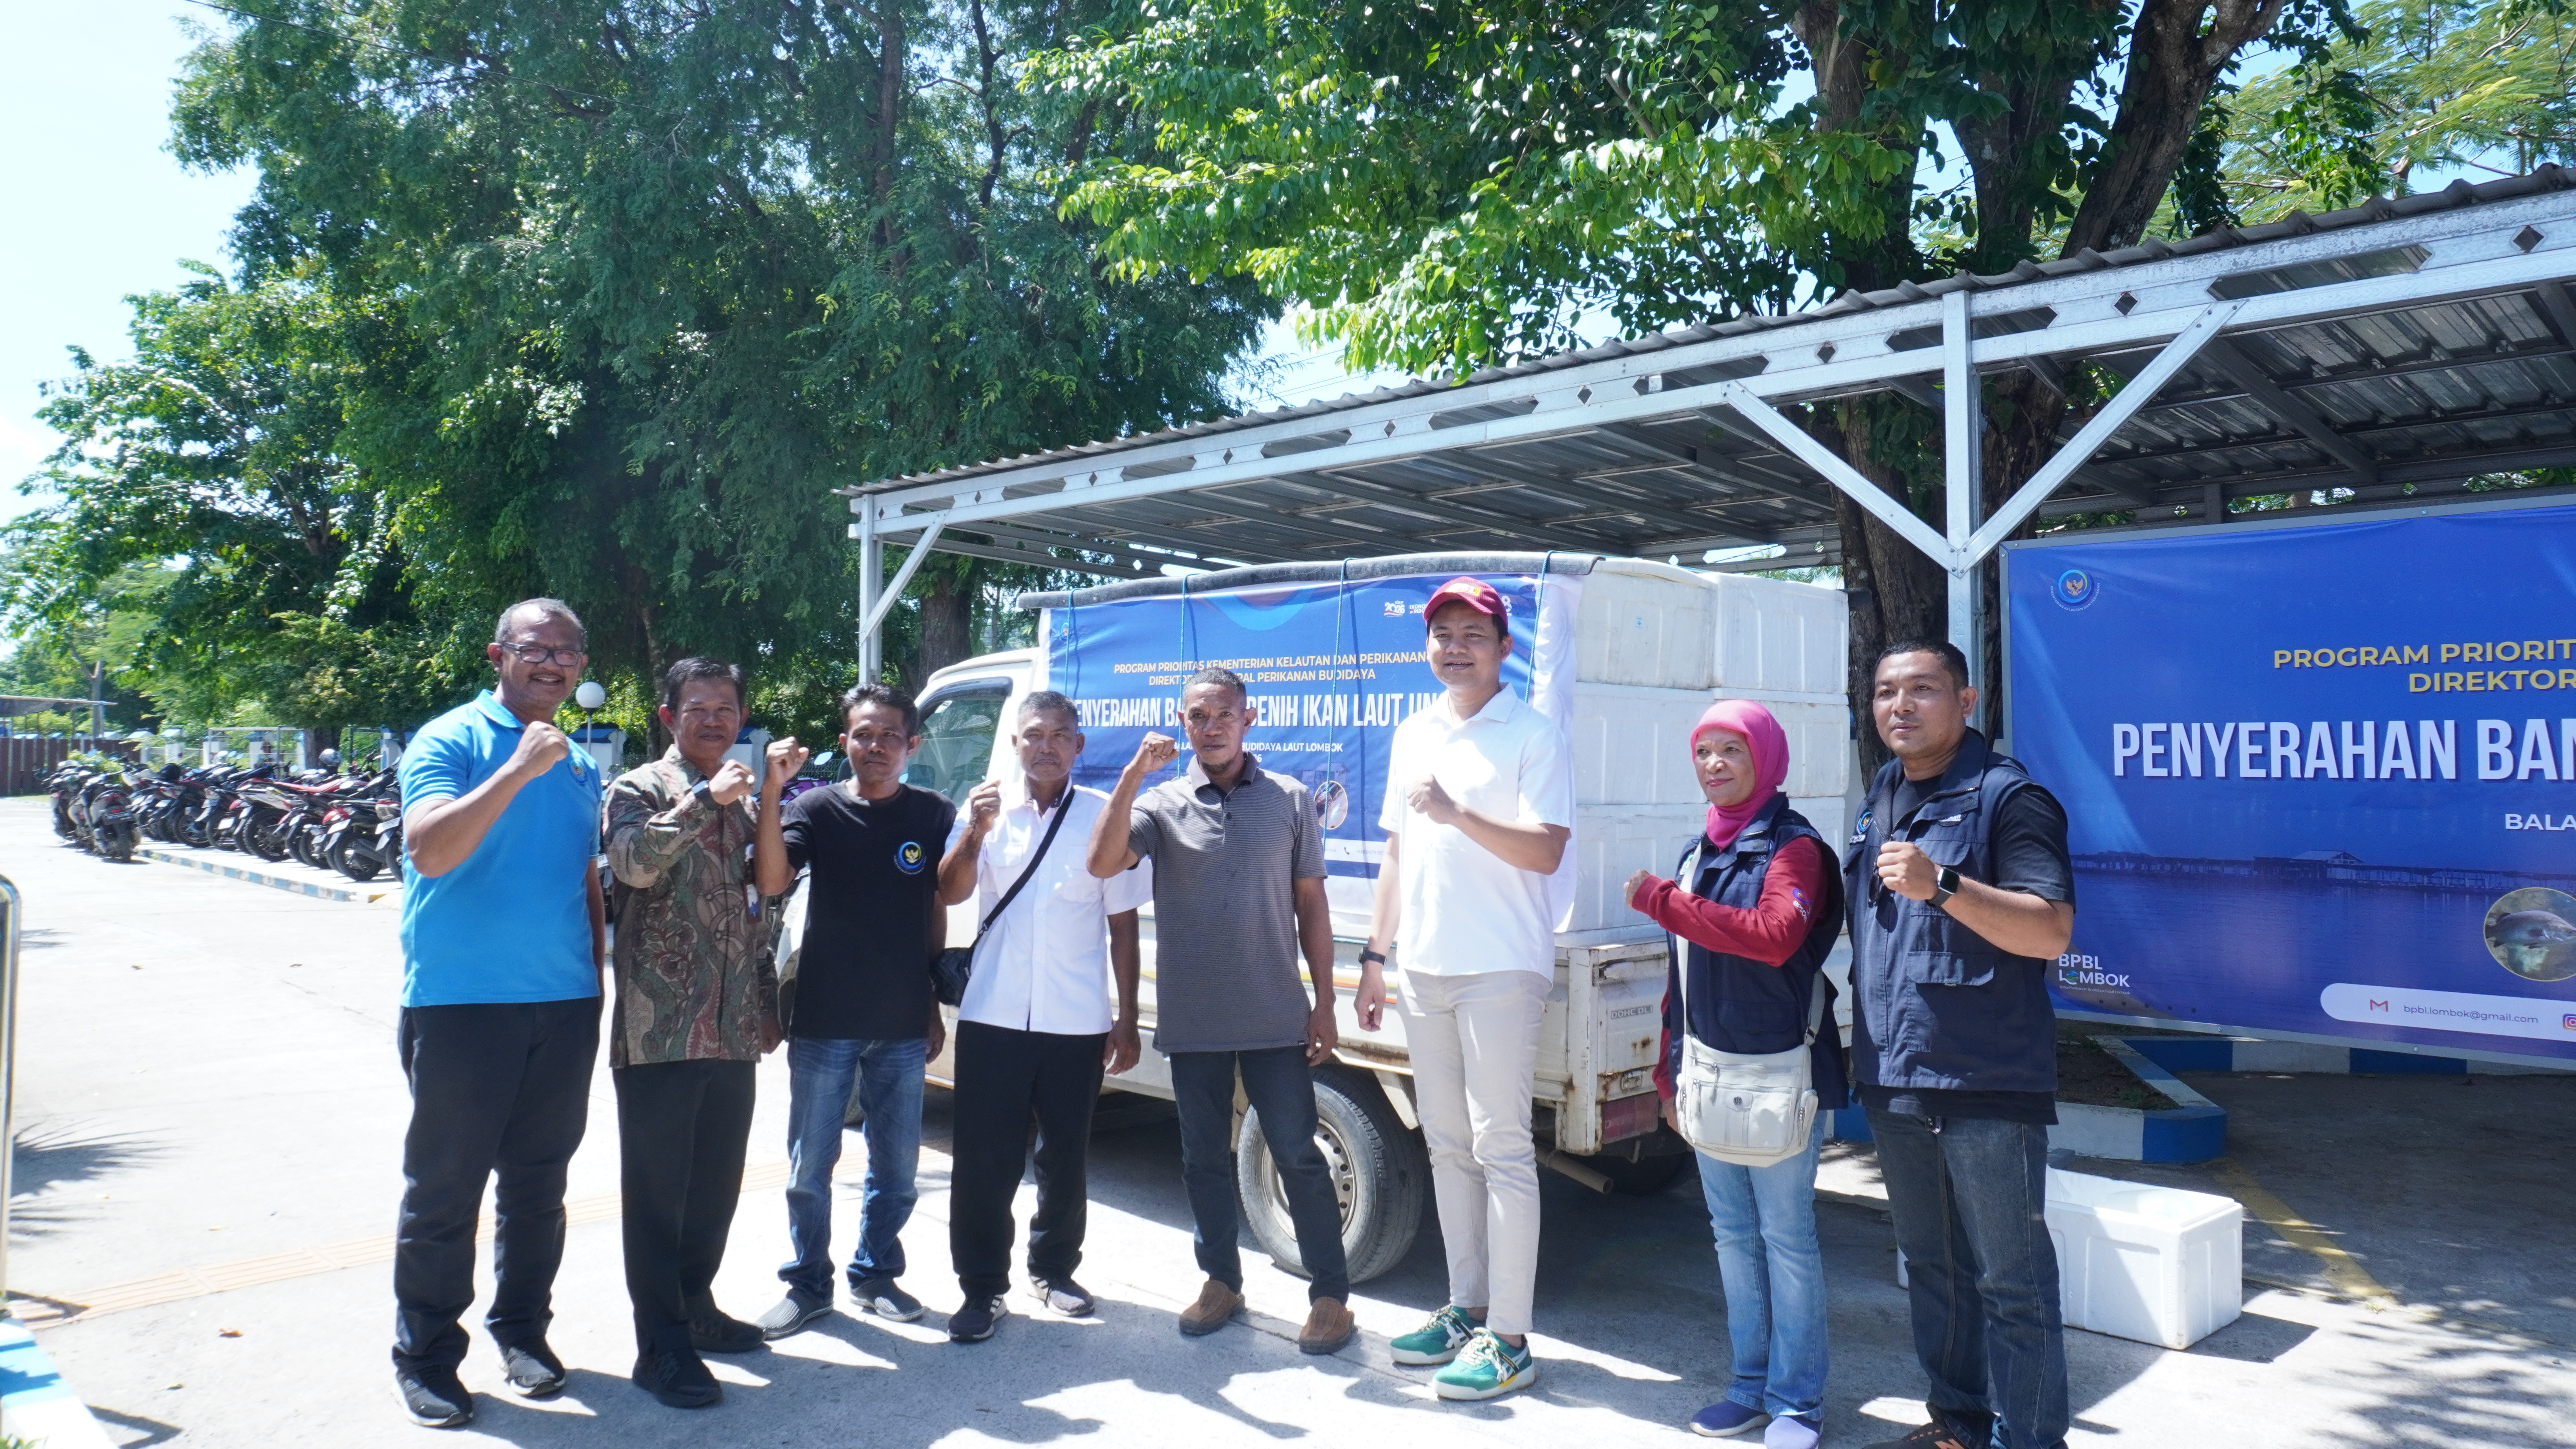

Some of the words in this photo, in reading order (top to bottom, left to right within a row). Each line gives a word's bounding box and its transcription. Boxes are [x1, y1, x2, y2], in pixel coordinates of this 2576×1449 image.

[1384, 602, 1405, 614] 2026
[1114, 663, 1156, 673] PROGRAM
[1158, 661, 1204, 672] PRIORITAS
[1206, 658, 1274, 670] KEMENTERIAN
[1276, 655, 1330, 667] KELAUTAN
[1334, 654, 1357, 665] DAN
[1359, 651, 1426, 664] PERIKANAN
[2274, 645, 2429, 668] PROGRAM
[2440, 639, 2576, 663] PRIORIT
[1149, 674, 1193, 686] DIREKTO
[1258, 670, 1315, 682] PERIKANAN
[1319, 668, 1376, 681] BUDIDAYA
[2409, 668, 2576, 692] DIREKTOR
[1074, 698, 1161, 727] ENYERAHAN
[1303, 694, 1348, 727] IKAN
[1353, 693, 1404, 727] LAUT
[1283, 743, 1304, 752] LAUT
[1306, 743, 1343, 752] LOMBOK
[2113, 720, 2457, 779] PENYERAHAN
[2059, 953, 2103, 970] BPBL
[1612, 1008, 1637, 1019] DOHC
[1638, 1005, 1653, 1014] DLI
[2404, 1004, 2539, 1024] bpbl.lombok@gmail.com
